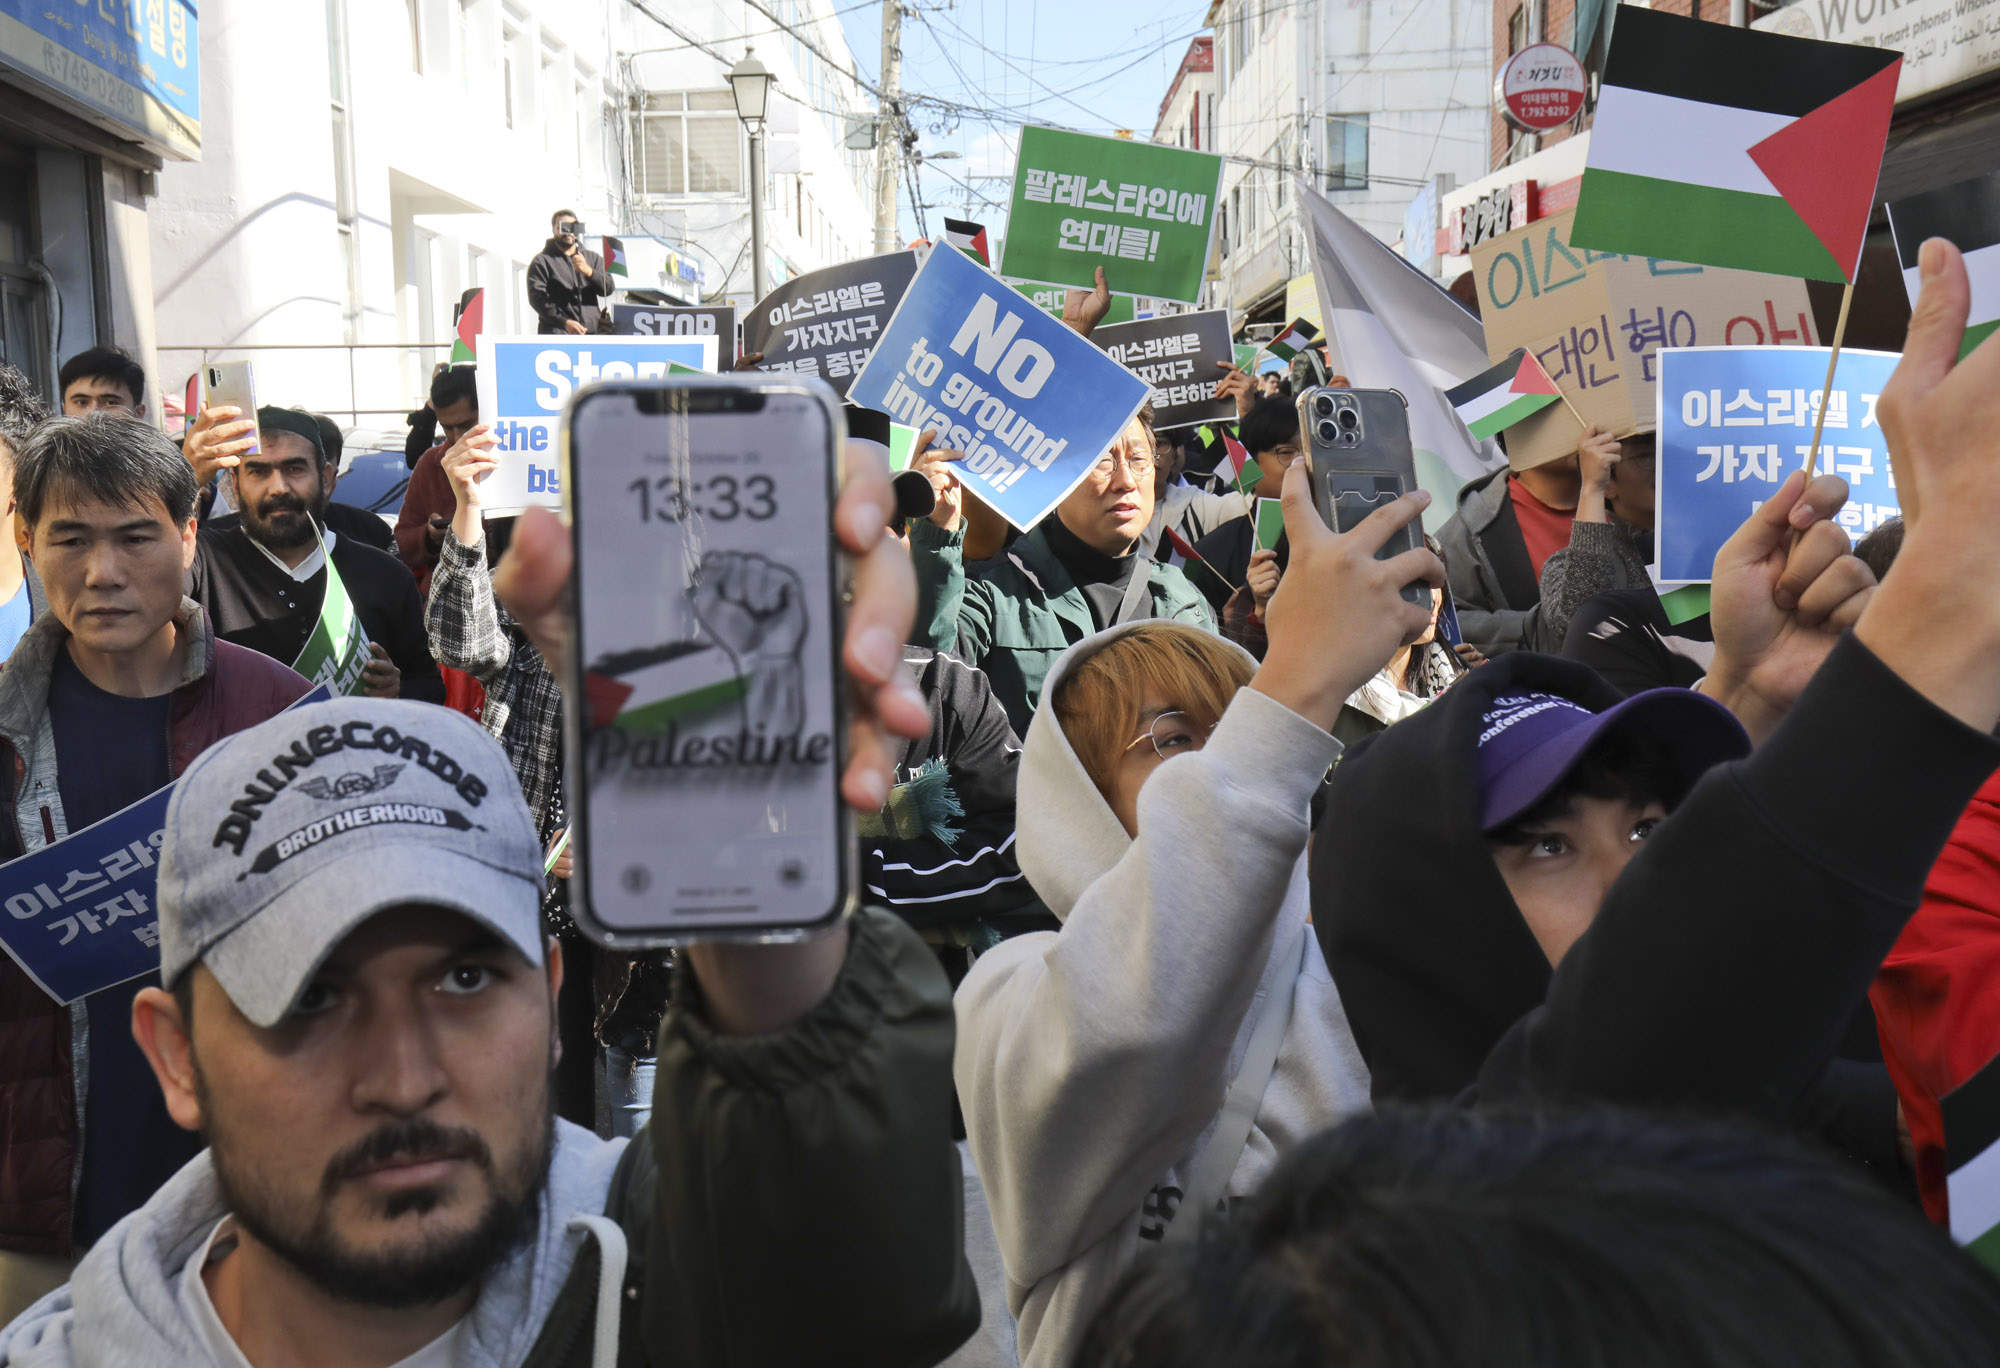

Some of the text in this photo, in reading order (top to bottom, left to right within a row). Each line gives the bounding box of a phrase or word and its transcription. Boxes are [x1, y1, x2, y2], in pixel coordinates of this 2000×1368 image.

[1879, 23, 1911, 48] Smart
[1912, 8, 1952, 38] phones
[1024, 168, 1207, 226] 팔레스타인에
[1058, 218, 1160, 262] 연대를!
[769, 281, 886, 326] 이스라엘은
[784, 315, 879, 352] 가자지구
[1107, 333, 1201, 363] 이스라엘은
[1131, 359, 1194, 384] 자지구
[905, 336, 1069, 472] to ground
[1681, 388, 1849, 429] 이스라엘
[495, 421, 548, 451] the
[881, 371, 1030, 493] invasion!
[1696, 444, 1783, 483] 가자
[1795, 444, 1874, 485] 지구
[628, 474, 778, 523] 13:33
[587, 719, 832, 770] Palestine
[276, 802, 448, 860] BROTHERHOOD
[46, 888, 150, 946] 가자
